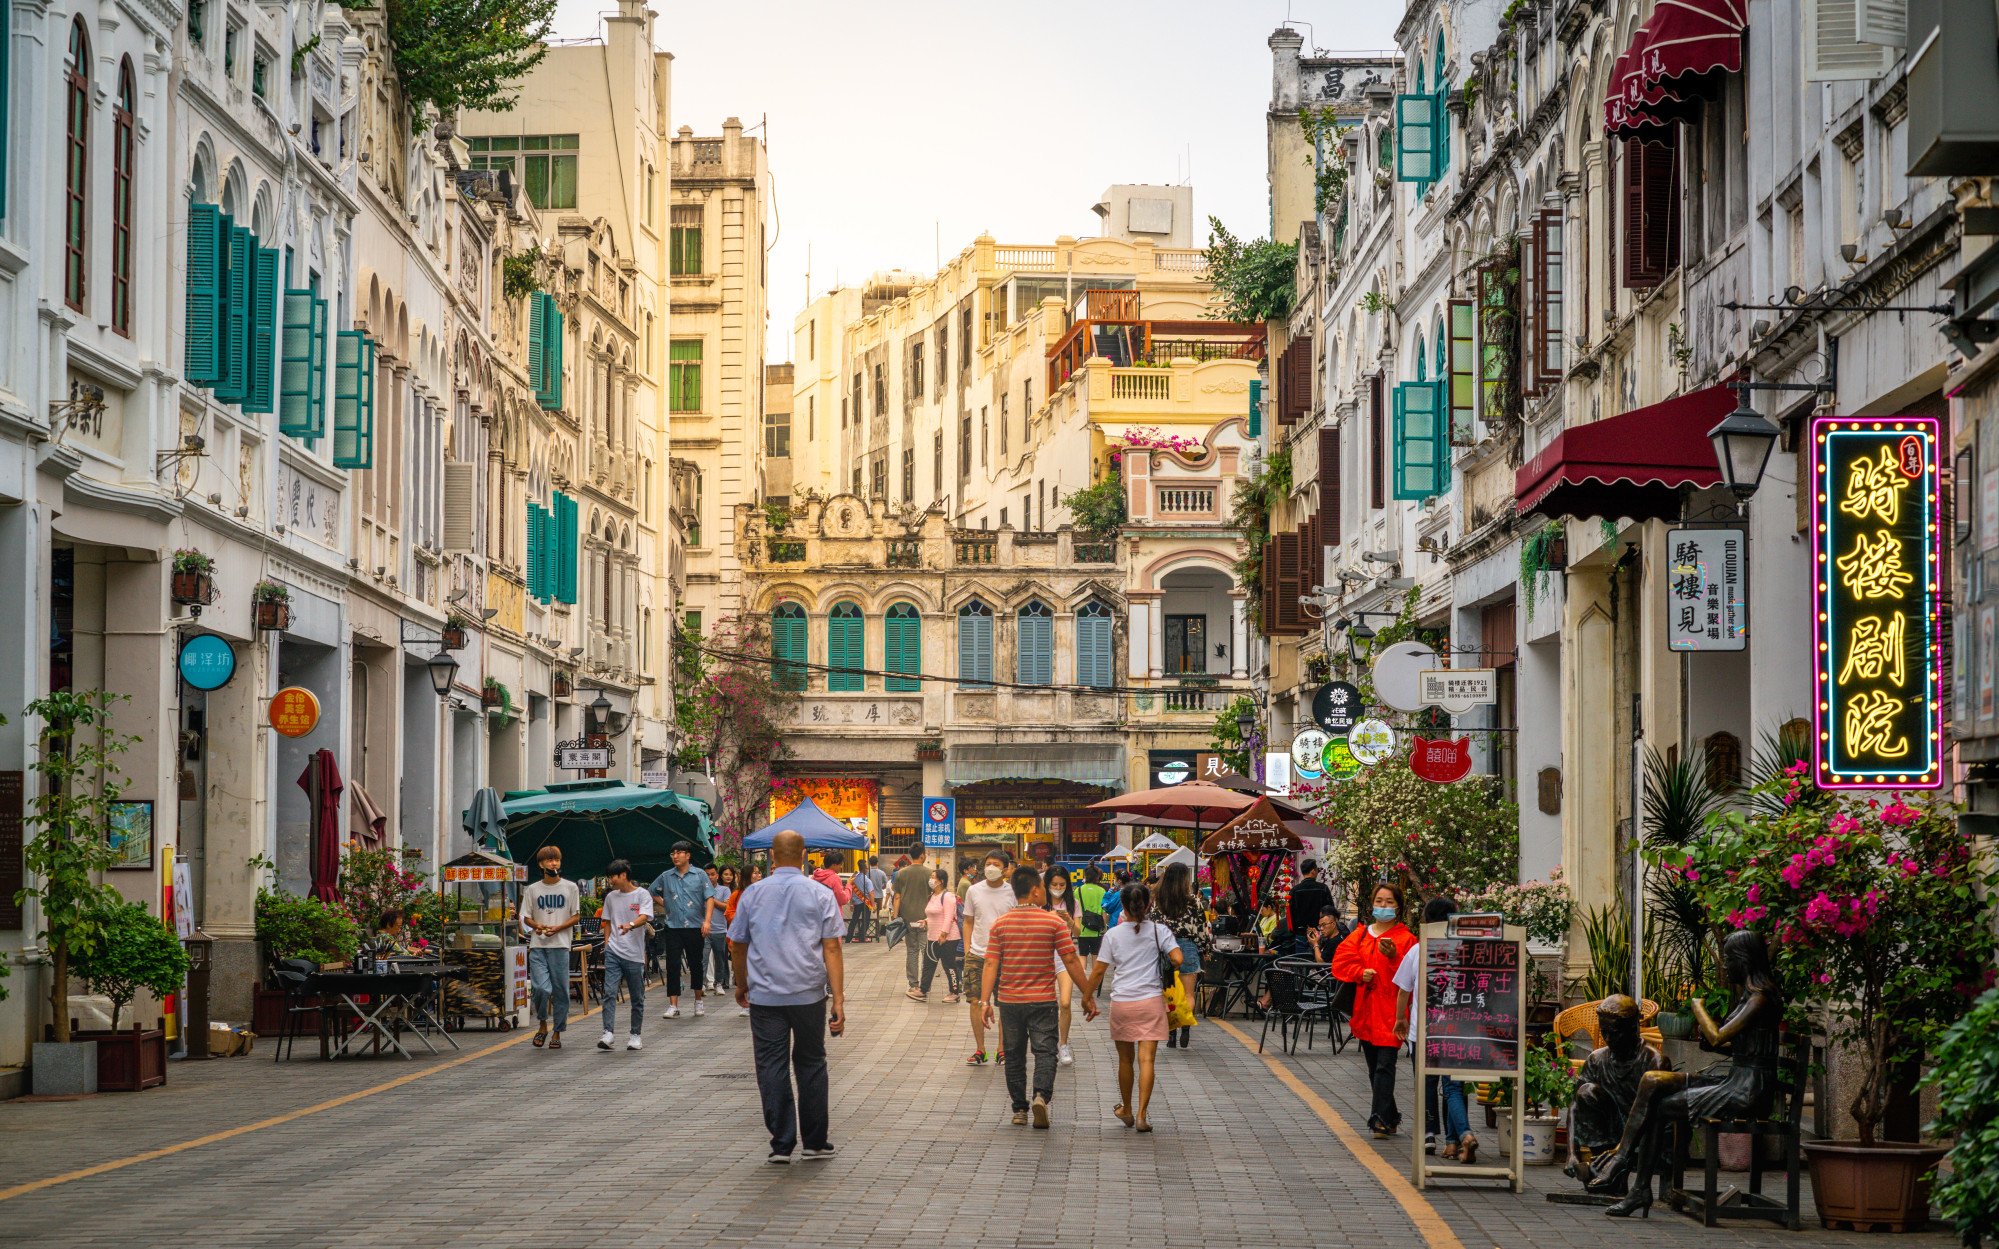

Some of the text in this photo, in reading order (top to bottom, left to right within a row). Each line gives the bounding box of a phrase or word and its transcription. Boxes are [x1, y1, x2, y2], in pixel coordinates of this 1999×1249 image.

[1902, 441, 1921, 476] 百年
[1672, 540, 1705, 634] 騎樓見
[1724, 539, 1738, 639] QILOUJIAN music gather spot
[1836, 444, 1914, 759] 骑楼剧院
[1707, 583, 1720, 640] 音樂聚場
[924, 834, 951, 845] 动车停放
[925, 822, 951, 833] 禁止非机
[1433, 942, 1517, 966] 百年剧院
[1433, 969, 1512, 993] 今日演出
